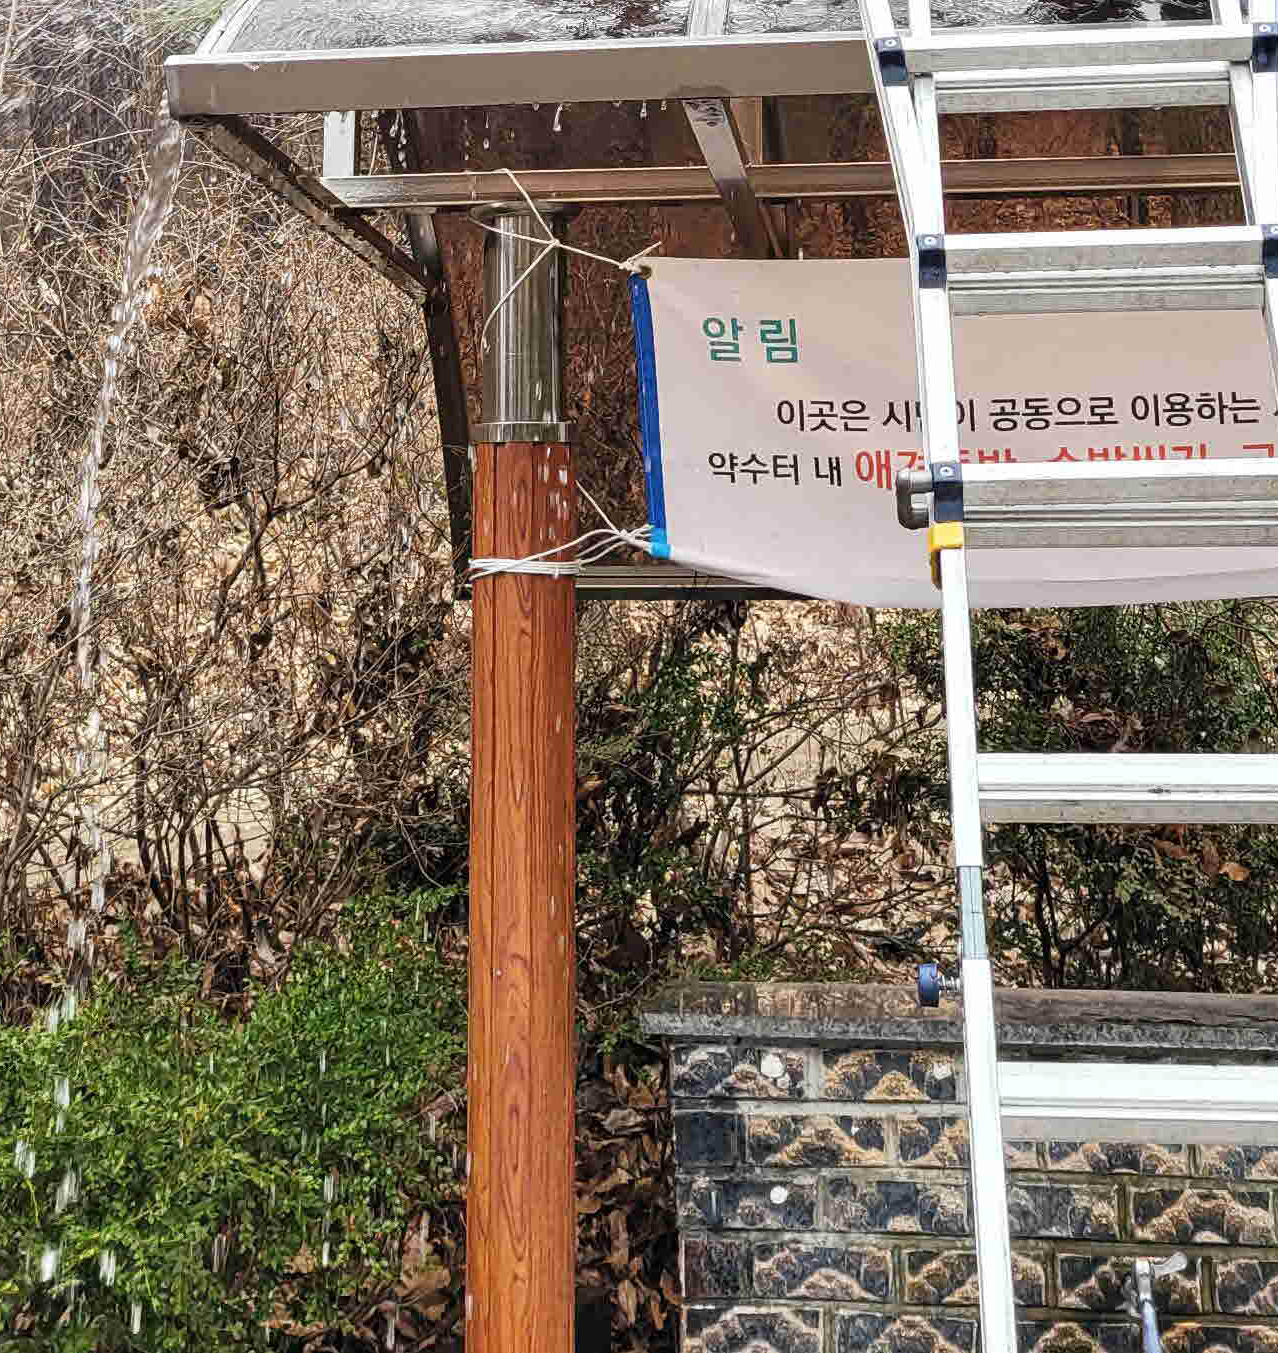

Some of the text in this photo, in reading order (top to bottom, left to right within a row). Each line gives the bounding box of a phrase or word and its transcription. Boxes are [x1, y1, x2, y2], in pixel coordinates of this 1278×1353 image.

[776, 399, 870, 432] 이곳은
[988, 395, 1120, 432] 공동으로
[1130, 390, 1262, 427] 이용하는
[708, 452, 800, 486] 약수터
[814, 456, 842, 487] 내
